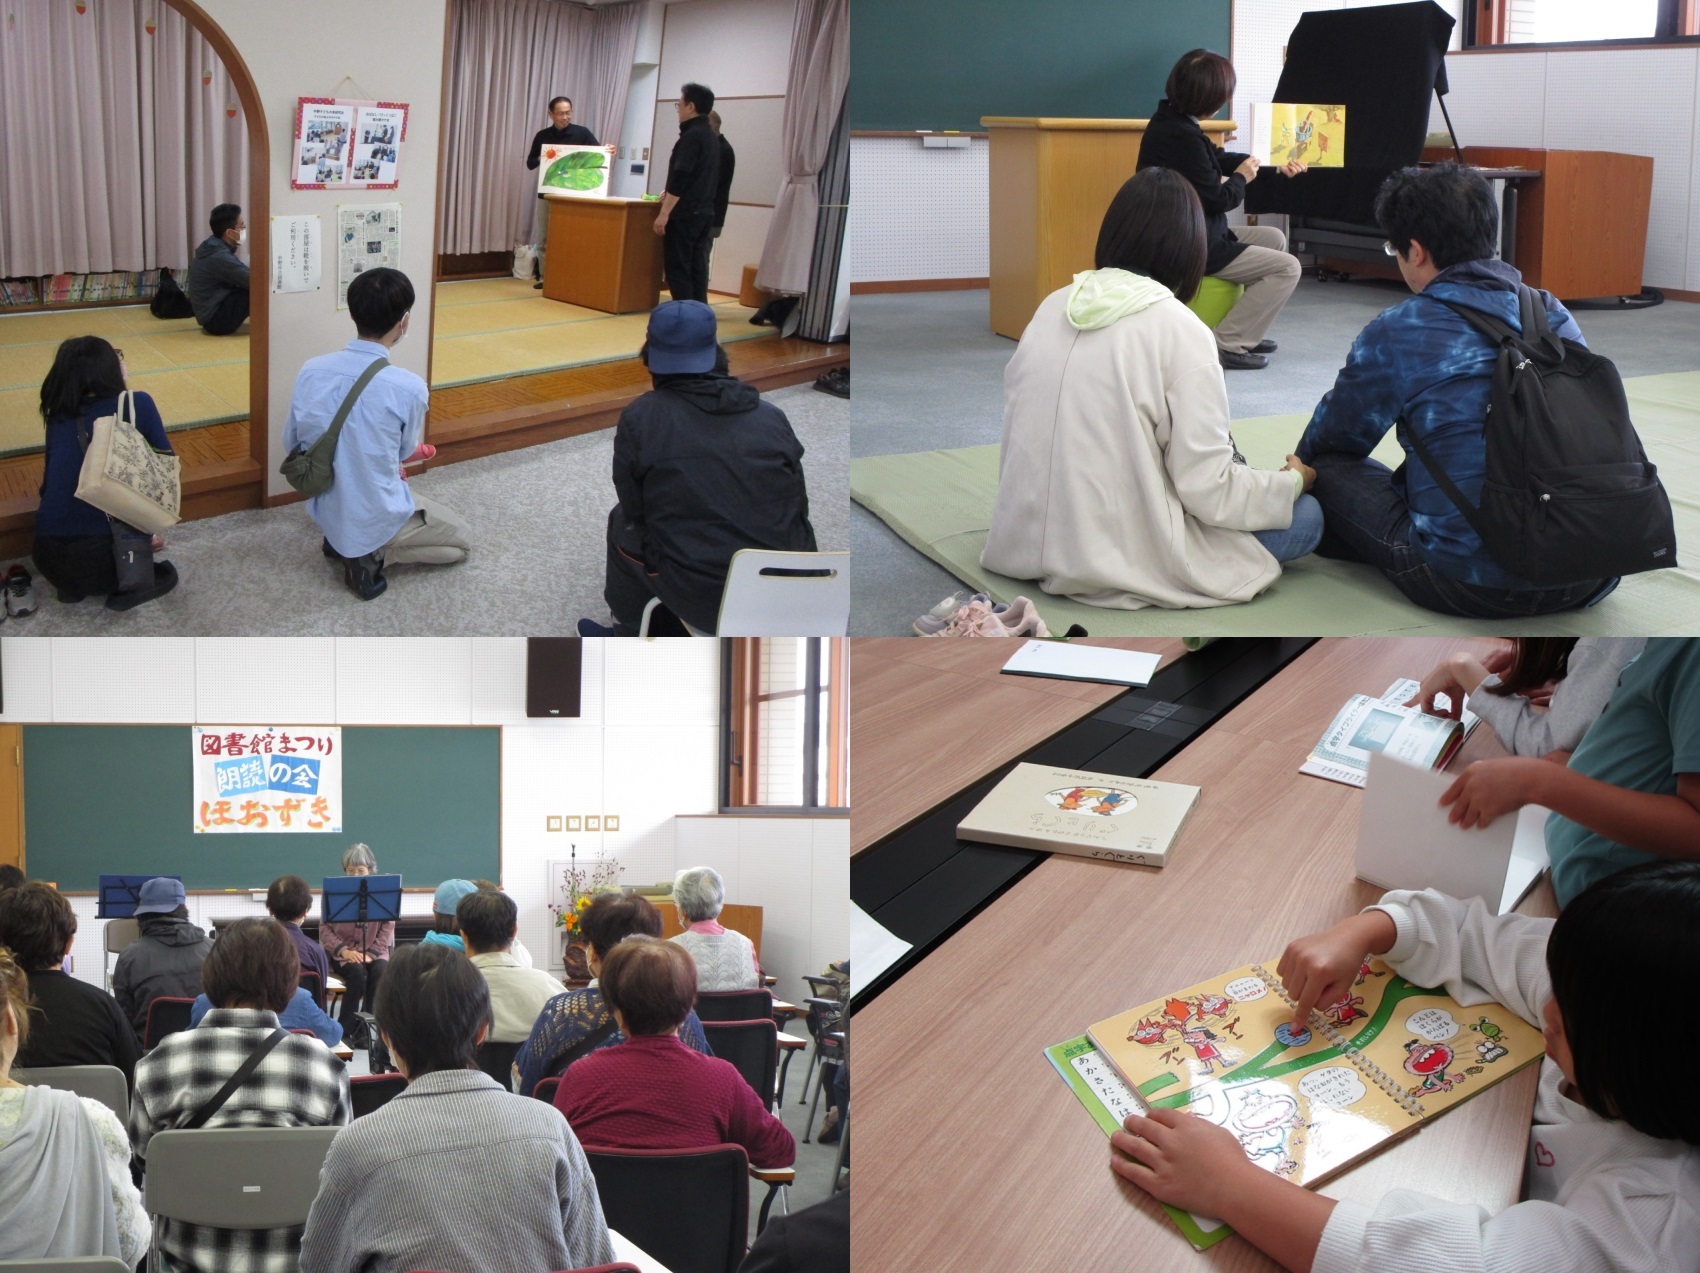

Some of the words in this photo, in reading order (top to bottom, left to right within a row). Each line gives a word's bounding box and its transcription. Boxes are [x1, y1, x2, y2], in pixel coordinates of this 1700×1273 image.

[201, 732, 333, 756] 図書館まつり
[216, 759, 319, 794] 朗読の会
[200, 795, 333, 830] ほおずき
[1030, 812, 1120, 834] ぐりとぐら
[1413, 1010, 1437, 1024] こんどは
[1426, 1021, 1450, 1036] がんばる
[1077, 1057, 1089, 1066] あ
[1085, 1067, 1098, 1075] か
[1094, 1076, 1104, 1085] さ
[1102, 1086, 1115, 1096] た
[1111, 1097, 1123, 1106] な
